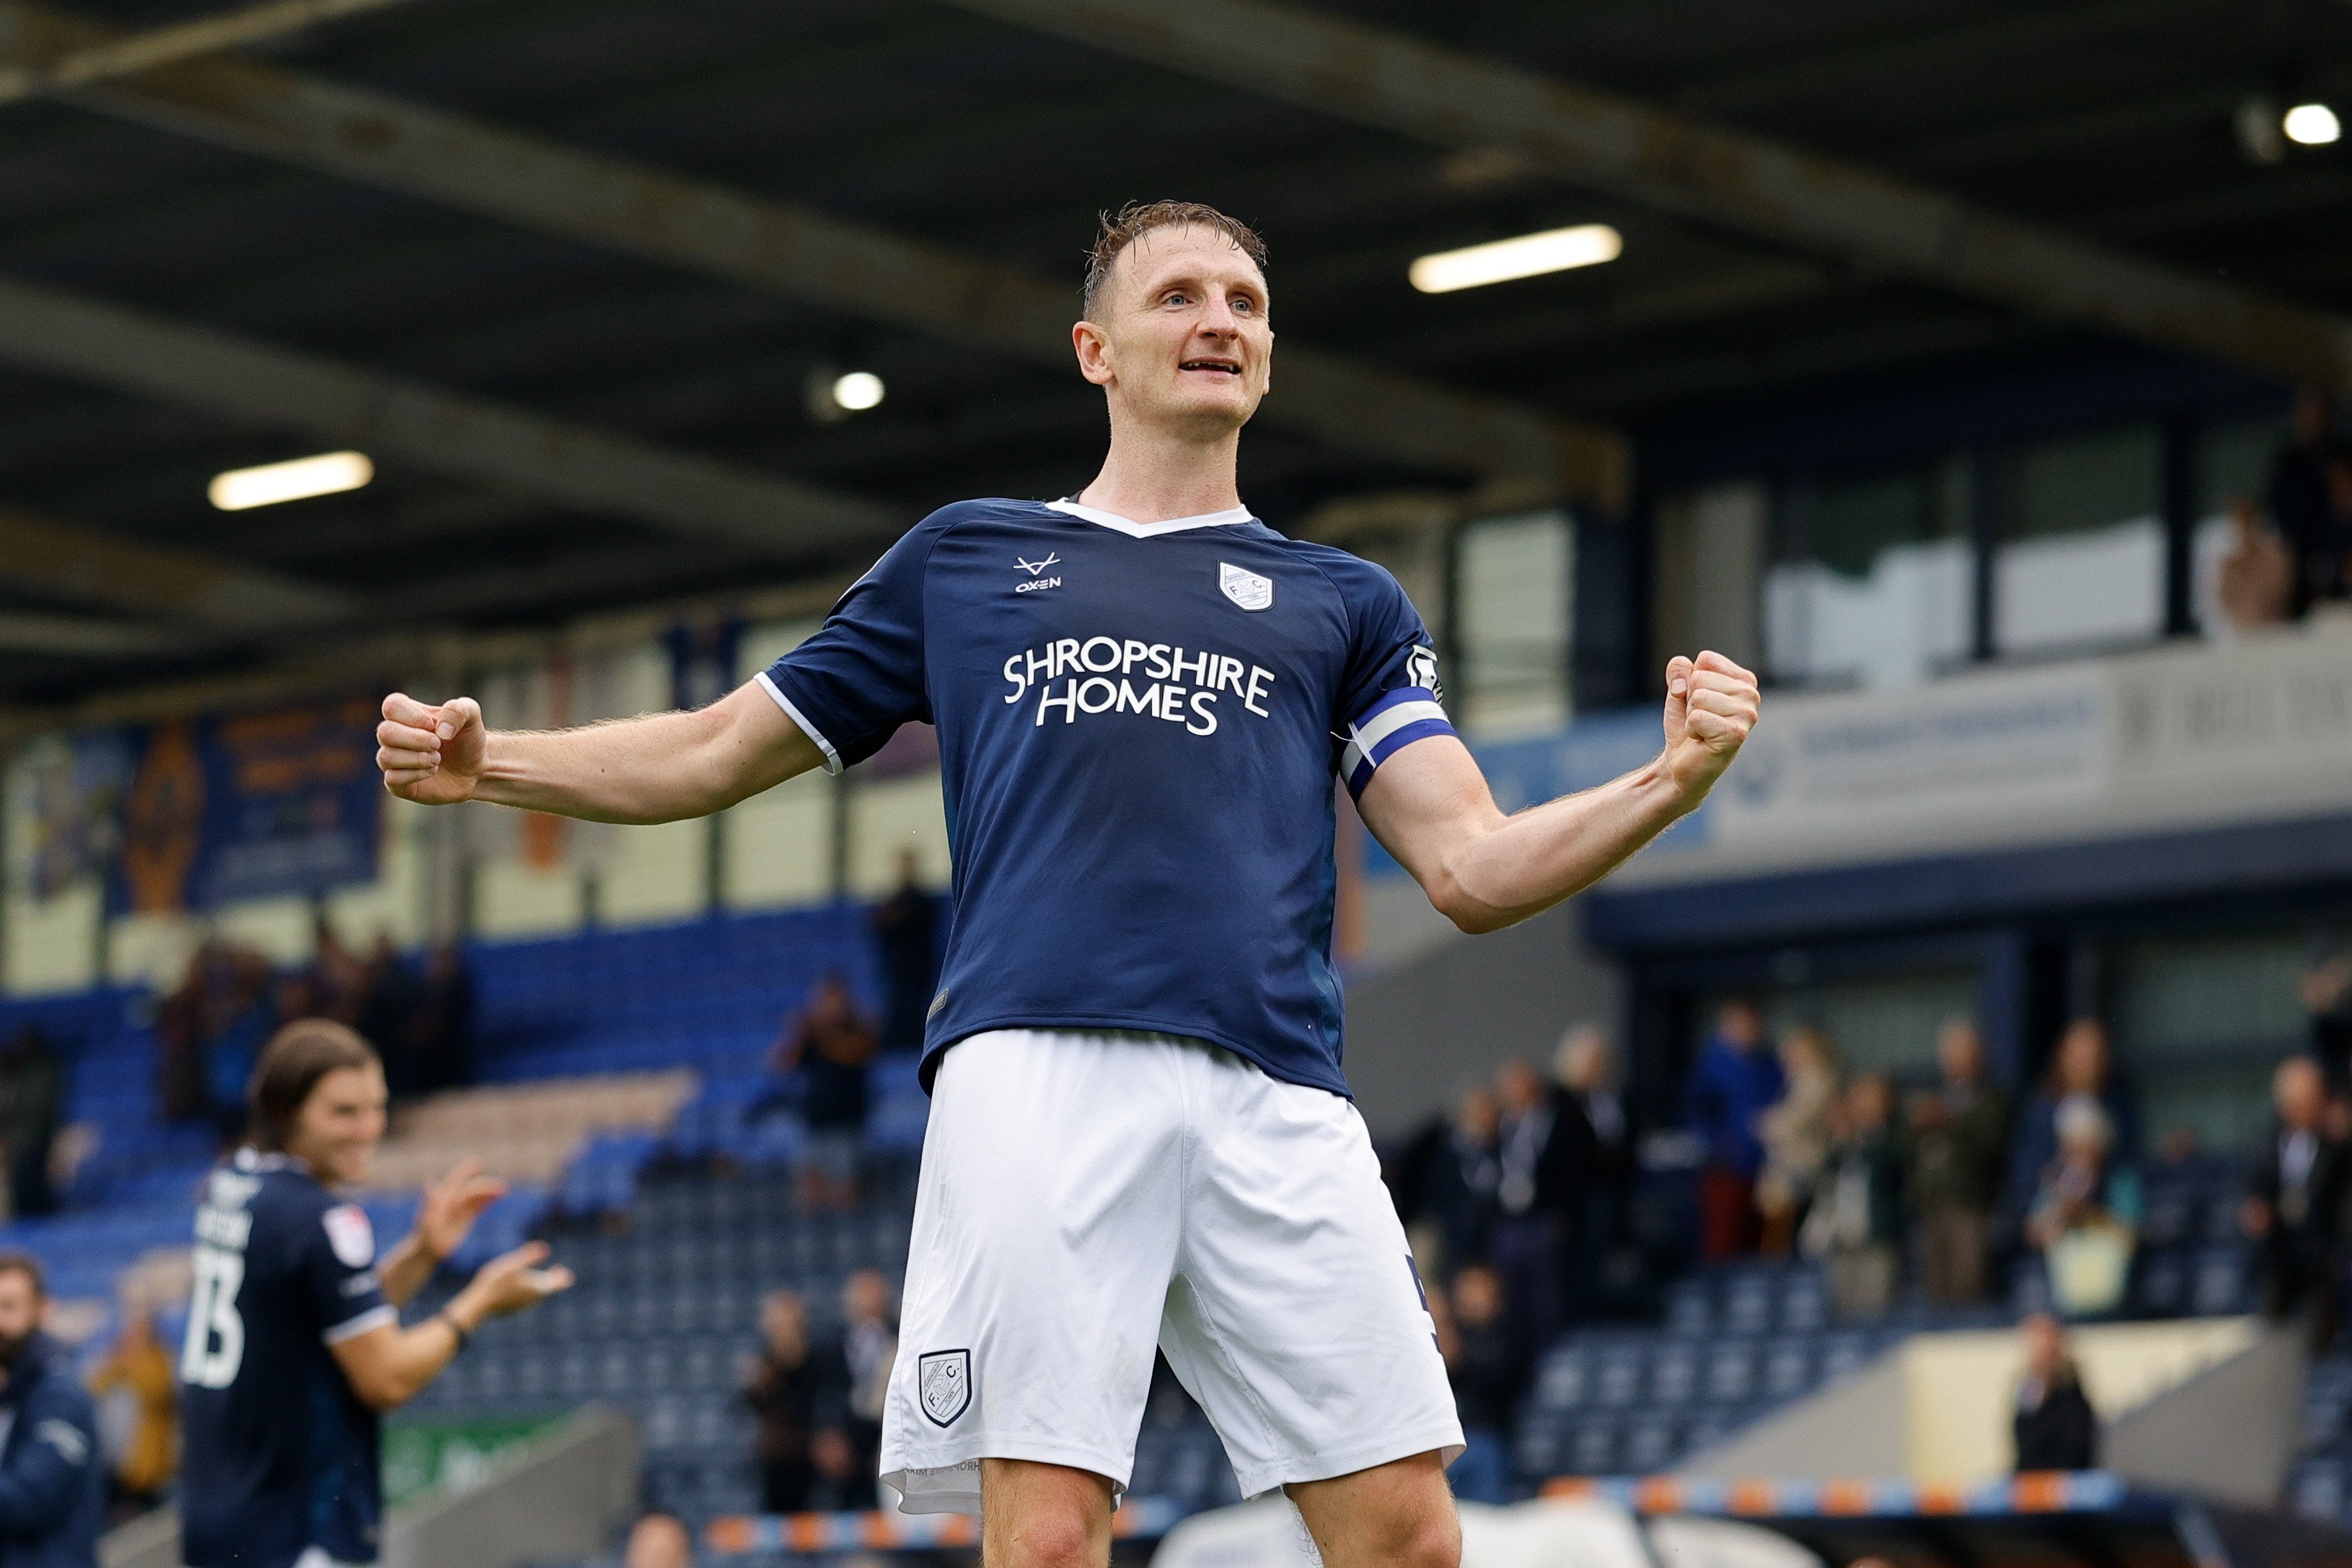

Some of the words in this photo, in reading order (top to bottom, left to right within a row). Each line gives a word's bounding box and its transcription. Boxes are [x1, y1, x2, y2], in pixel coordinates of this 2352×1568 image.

[1015, 576, 1061, 593] OXEN
[1004, 636, 1275, 718] SHROPSHIRE
[1036, 677, 1217, 736] HOMES
[180, 1245, 245, 1388] 13
